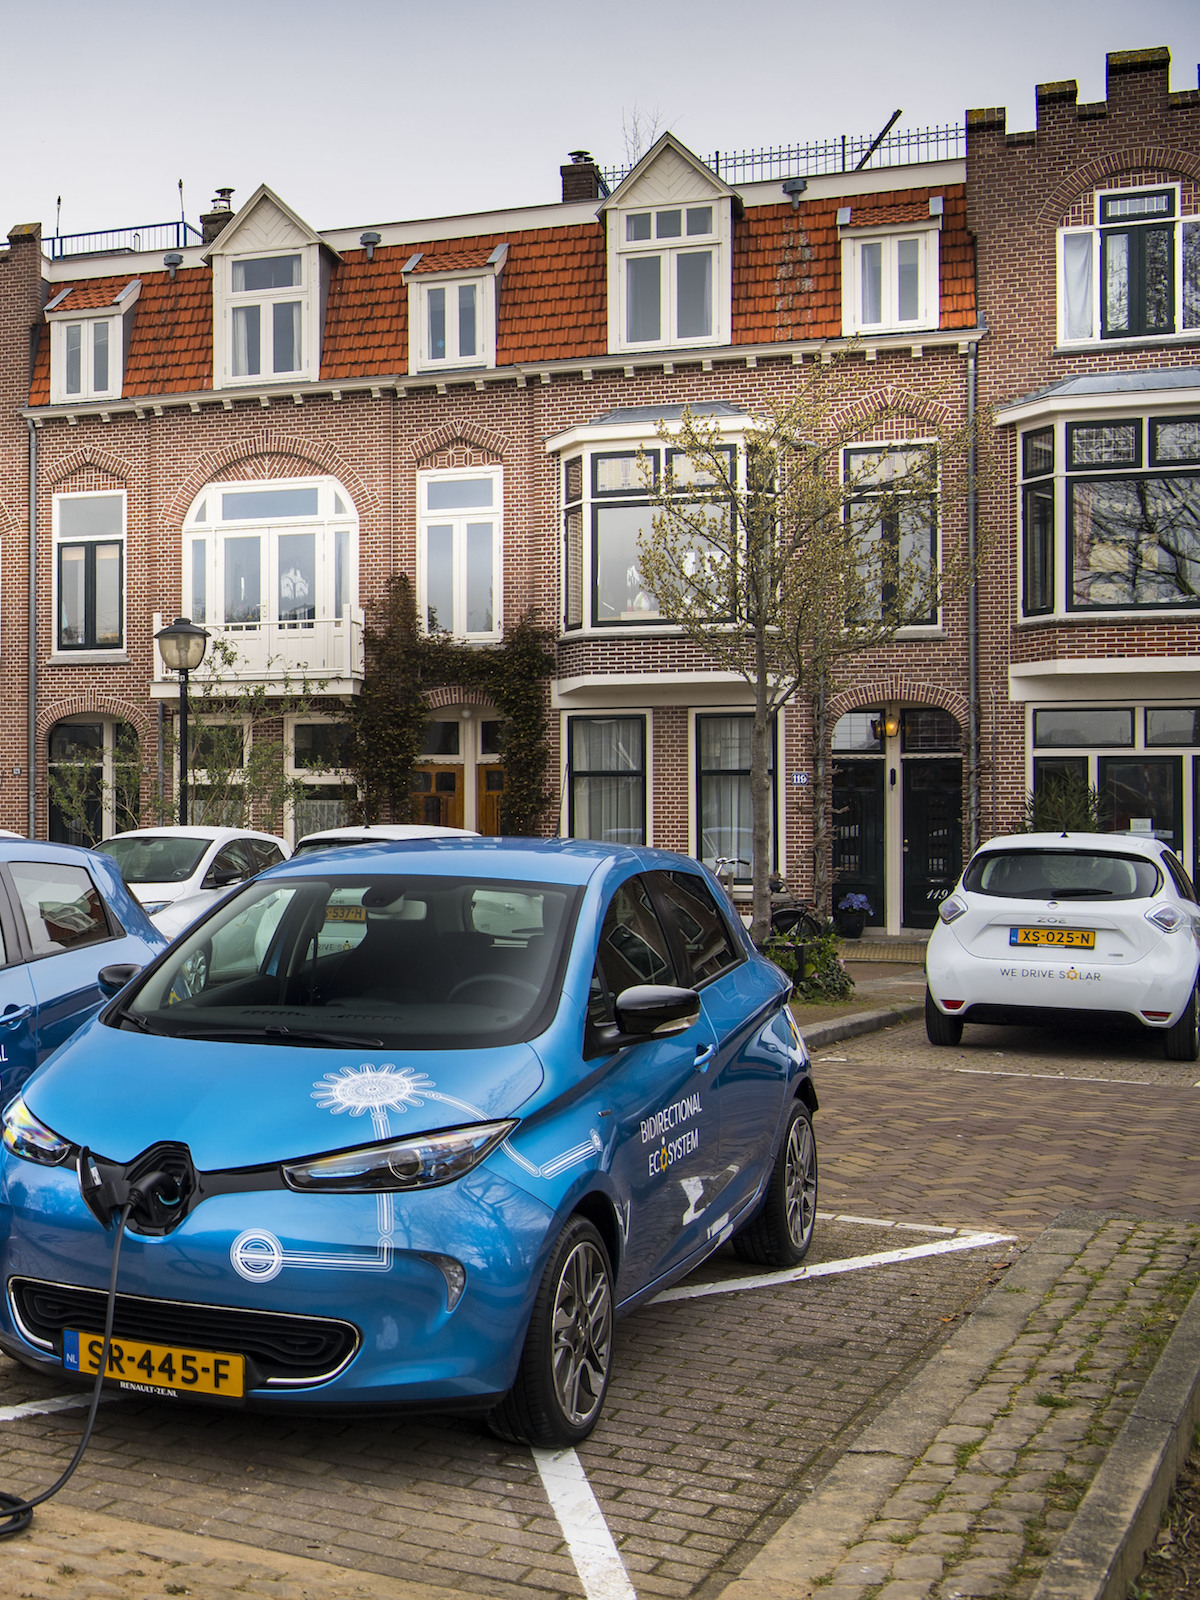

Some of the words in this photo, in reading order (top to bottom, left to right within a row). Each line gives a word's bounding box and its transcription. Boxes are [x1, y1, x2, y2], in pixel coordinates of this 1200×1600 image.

[792, 774, 808, 784] 119
[926, 888, 949, 900] 119
[1037, 916, 1067, 924] ZOE
[1022, 930, 1090, 945] XS-025-N
[1000, 968, 1017, 978] WE
[1021, 968, 1055, 979] DRIVE
[1059, 966, 1101, 981] SOLAR
[640, 1092, 702, 1143] BIDIRECTIONAL
[649, 1128, 699, 1177] ECOSYSTEM
[66, 1353, 77, 1364] NL
[88, 1340, 230, 1389] SR-445-F
